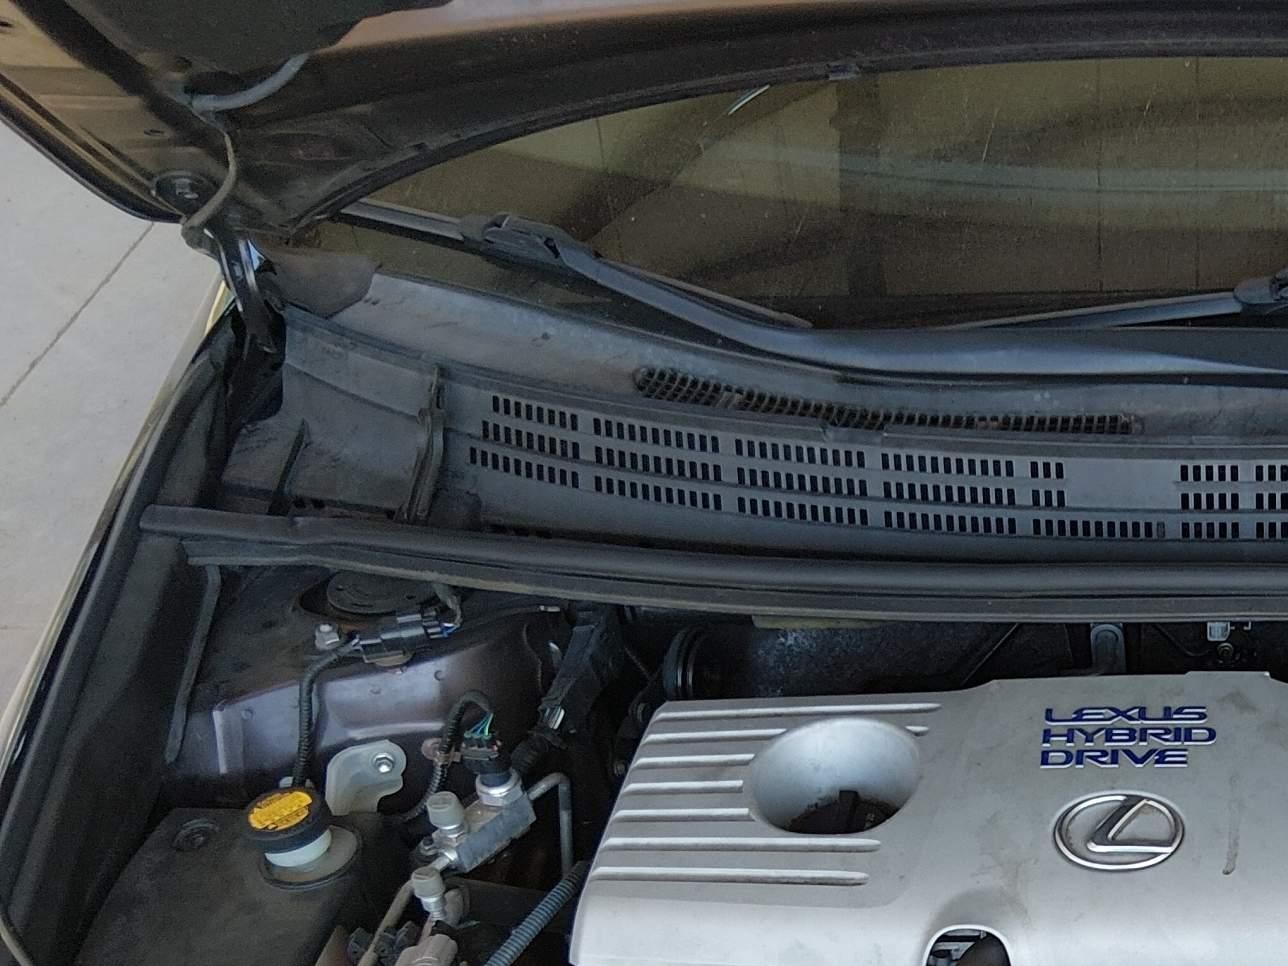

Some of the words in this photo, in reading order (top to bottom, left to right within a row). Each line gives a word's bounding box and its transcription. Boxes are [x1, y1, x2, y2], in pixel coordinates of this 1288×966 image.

[1045, 706, 1208, 725] LEXUS
[1042, 727, 1217, 746] HYBRID
[1040, 748, 1188, 769] DRIVE
